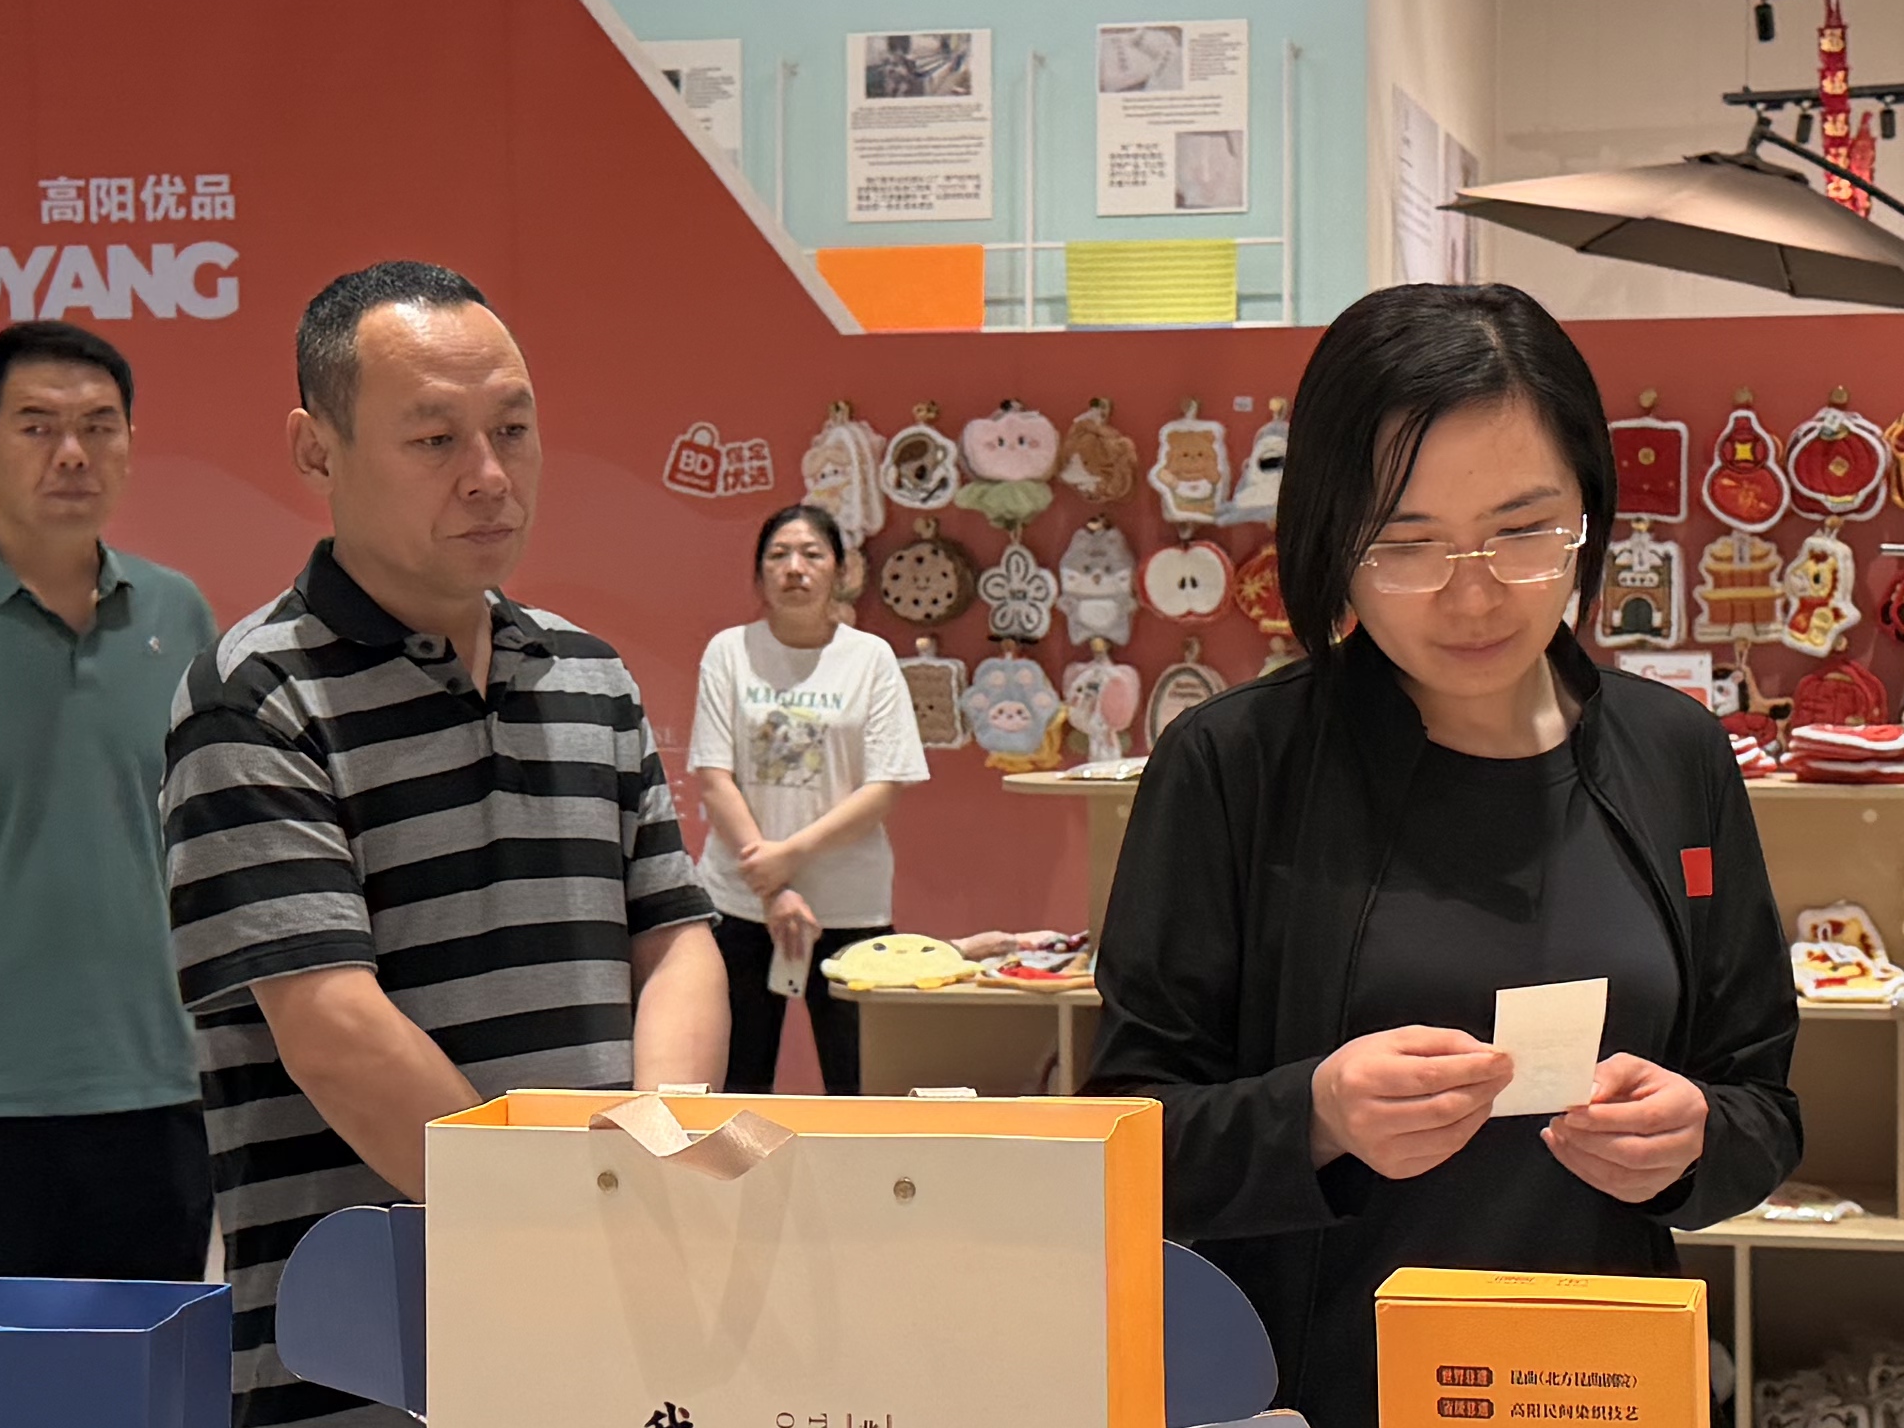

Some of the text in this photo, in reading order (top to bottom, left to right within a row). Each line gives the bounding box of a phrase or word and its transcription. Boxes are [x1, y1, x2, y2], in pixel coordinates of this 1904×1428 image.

[38, 174, 236, 224] 高阳优品
[678, 448, 712, 473] BD
[745, 685, 845, 711] MAGICIAN
[1510, 1403, 1640, 1422] 高阳民间染织技艺
